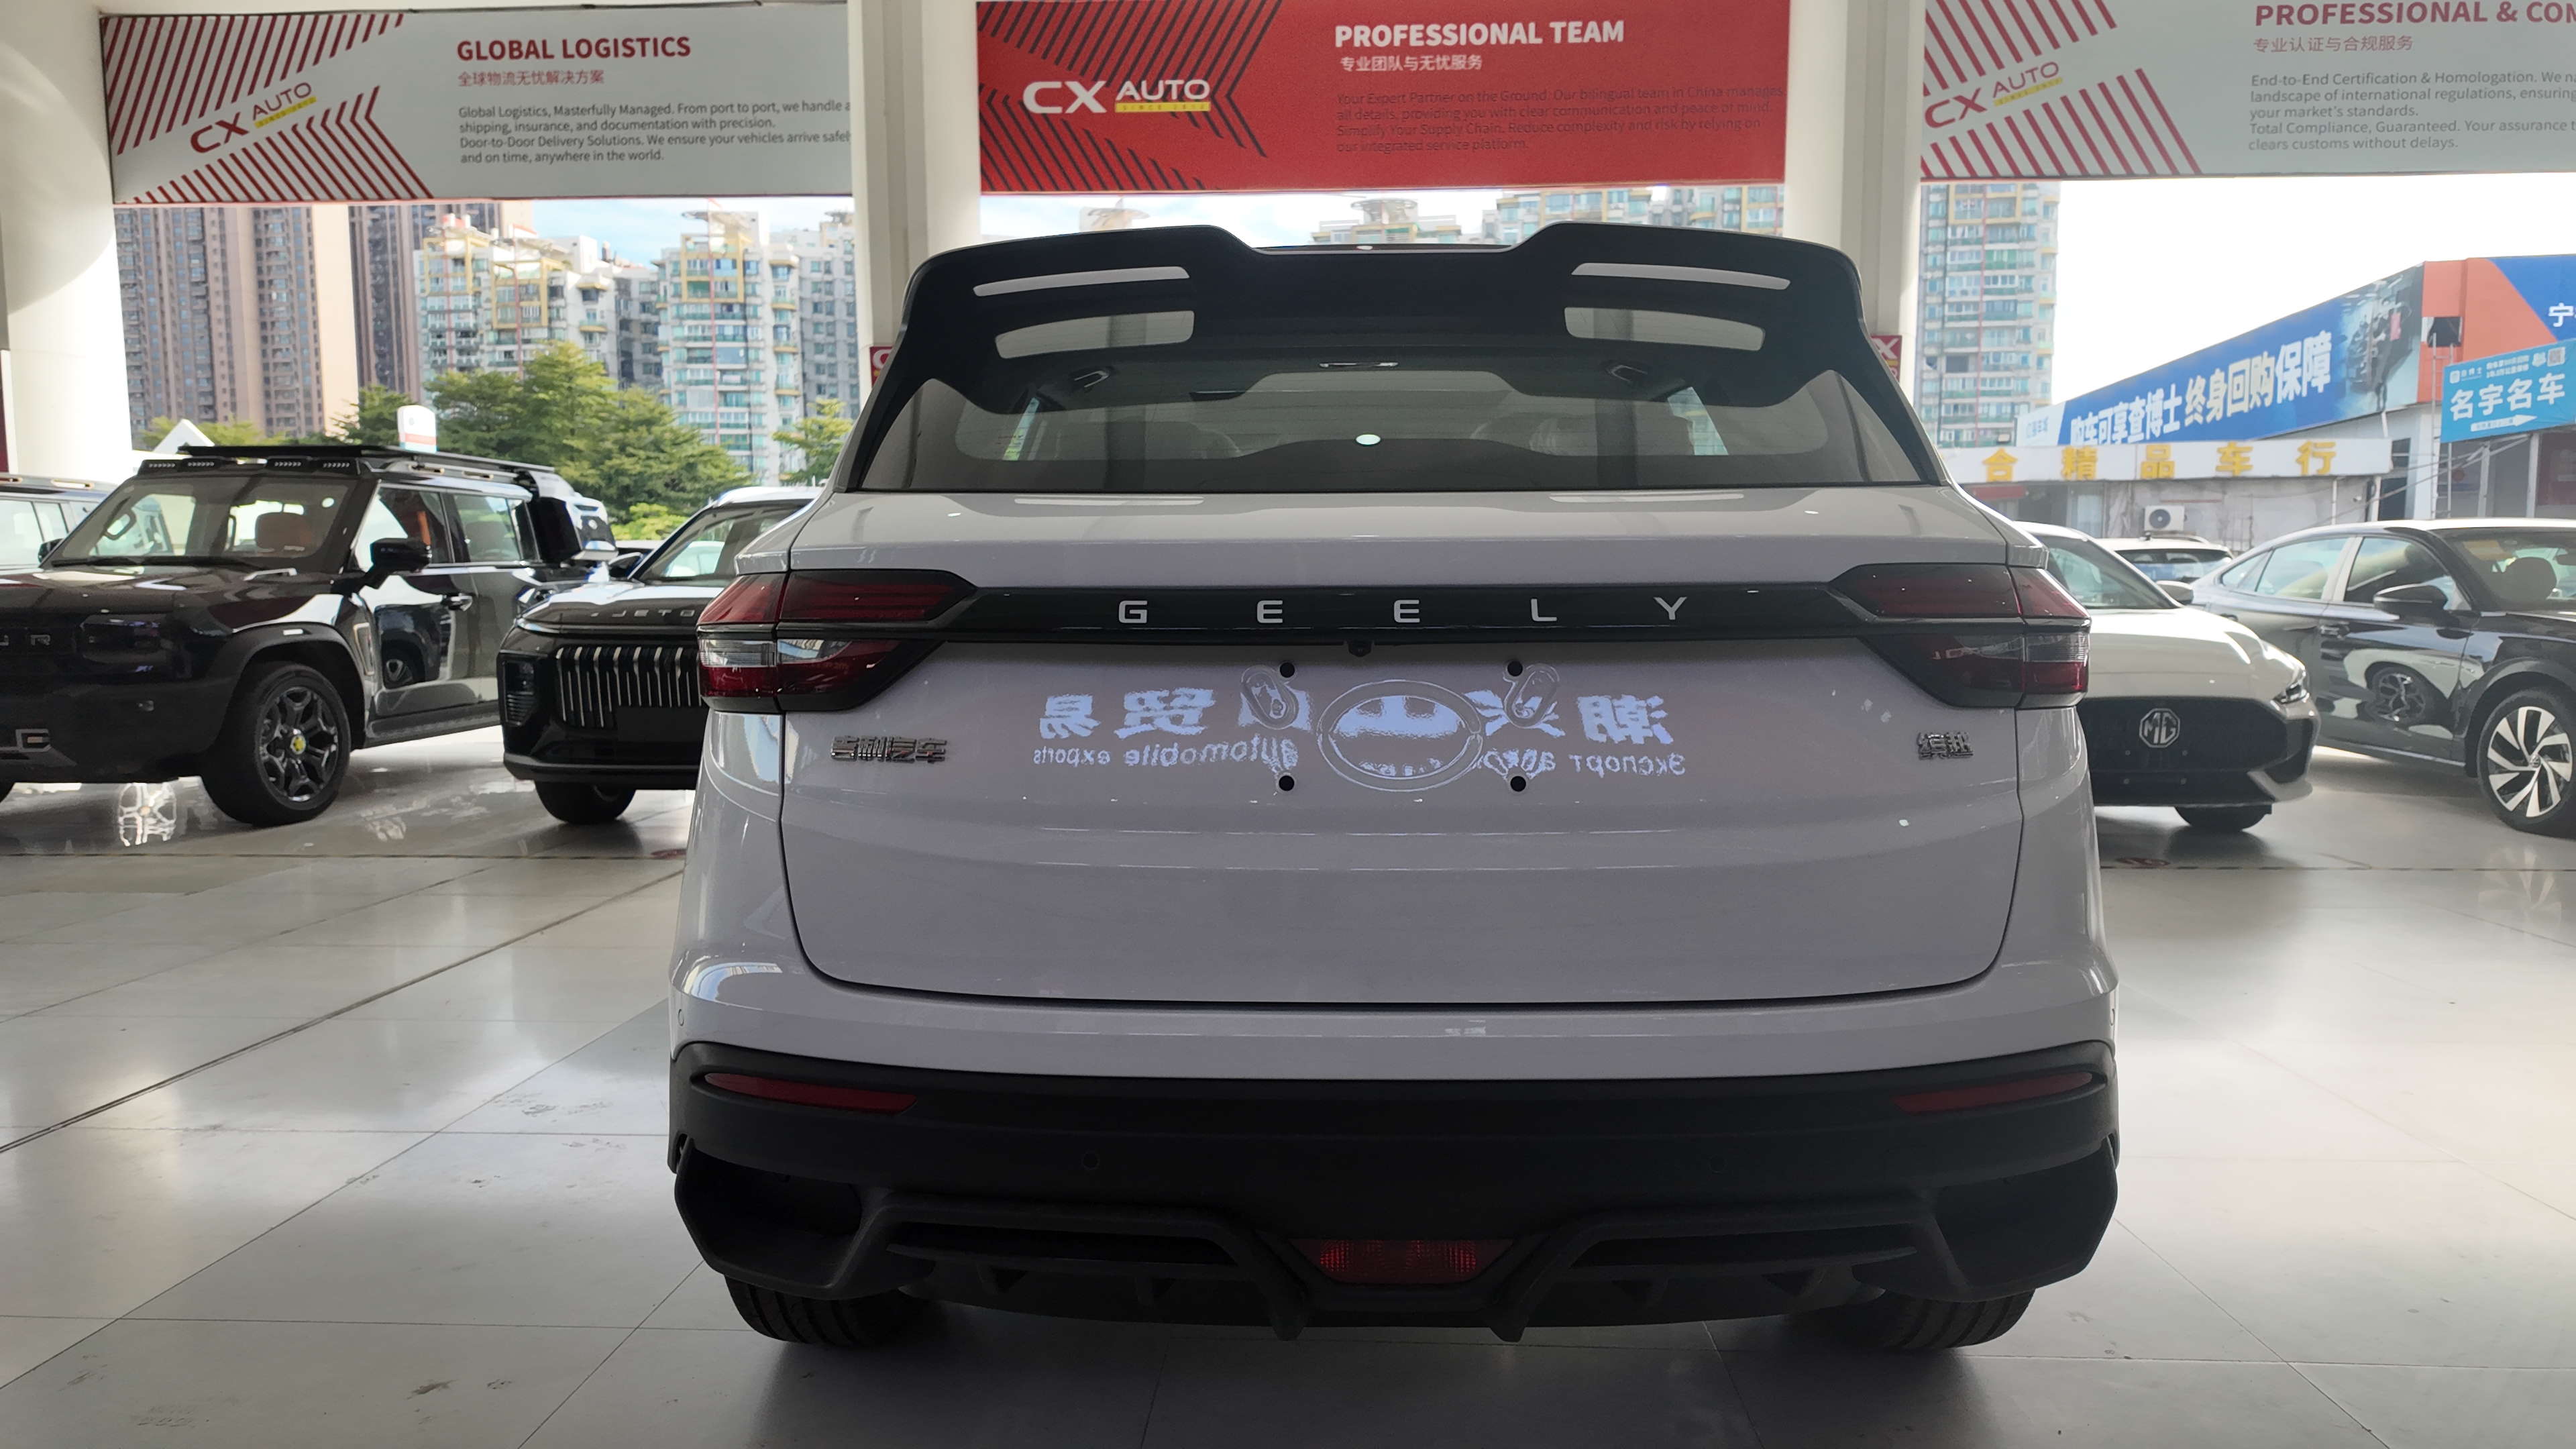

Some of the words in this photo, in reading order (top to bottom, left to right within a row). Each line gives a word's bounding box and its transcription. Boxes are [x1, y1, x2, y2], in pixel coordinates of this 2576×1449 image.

[2255, 1, 2488, 27] PROFESSIONAL
[2496, 1, 2518, 22] &
[1335, 21, 1543, 48] PROFESSIONAL
[1549, 20, 1624, 44] TEAM
[2253, 34, 2414, 53] 专业认证与合规服务
[457, 39, 555, 61] GLOBAL
[561, 36, 691, 59] LOGISTICS
[1340, 54, 1483, 72] 专业团队与无忧服务
[457, 69, 604, 87] 全球物流无忧解决方案
[2251, 73, 2329, 87] End-to-End
[2332, 72, 2417, 85] Certification
[2420, 72, 2431, 84] &
[2434, 71, 2537, 86] Homologation.
[2541, 71, 2562, 83] We
[1022, 80, 1107, 113] CX
[1116, 79, 1210, 101] AUTO
[1925, 87, 1988, 128] CX
[1992, 61, 2059, 99] AUTO
[2250, 90, 2321, 104] landscape
[2324, 89, 2339, 101] of
[2341, 87, 2431, 101] international
[2434, 87, 2516, 103] regulations,
[190, 111, 249, 154] CX
[251, 82, 313, 121] AUTO
[458, 106, 496, 118] Global
[498, 107, 551, 120] Logistics,
[553, 104, 616, 118] Masterfully
[619, 103, 675, 118] Managed.
[677, 103, 707, 115] From
[710, 103, 735, 116] port
[737, 103, 749, 113] to
[751, 102, 780, 115] port,
[782, 103, 800, 112] we
[801, 99, 843, 112] handle
[2249, 109, 2281, 121] your
[2284, 105, 2344, 118] market's
[2347, 104, 2418, 117] standards.
[459, 122, 512, 136] shipping,
[515, 118, 574, 133] insurance,
[576, 119, 598, 131] and
[600, 116, 689, 131] documentation
[691, 117, 717, 129] with
[719, 119, 775, 131] precision.
[2249, 122, 2283, 135] Total
[2286, 121, 2372, 136] Compliance,
[2375, 119, 2461, 133] Guaranteed.
[2464, 120, 2496, 131] Your
[2498, 121, 2568, 131] assurance
[460, 134, 535, 149] Door-to-Door
[538, 136, 584, 149] Delivery
[587, 135, 645, 146] Solutions.
[647, 135, 665, 146] We
[667, 136, 706, 145] ensure
[708, 133, 735, 147] your
[737, 132, 785, 144] vehicles
[786, 131, 820, 144] arrive
[2248, 138, 2289, 151] clears
[2292, 139, 2350, 150] customs
[2353, 137, 2407, 150] without
[2409, 136, 2459, 151] delays.
[460, 152, 482, 164] and
[484, 154, 500, 164] on
[502, 153, 532, 164] time,
[534, 150, 591, 165] anywhere
[593, 152, 604, 161] in
[606, 150, 626, 162] the
[628, 149, 665, 161] world.
[2548, 302, 2576, 327] 宁
[2184, 330, 2332, 427] 终身回购保障
[2450, 372, 2566, 421] 名宇名车
[1939, 440, 2338, 482] 合精品车行
[1118, 596, 1688, 625] GEELY
[2143, 712, 2177, 744] MG
